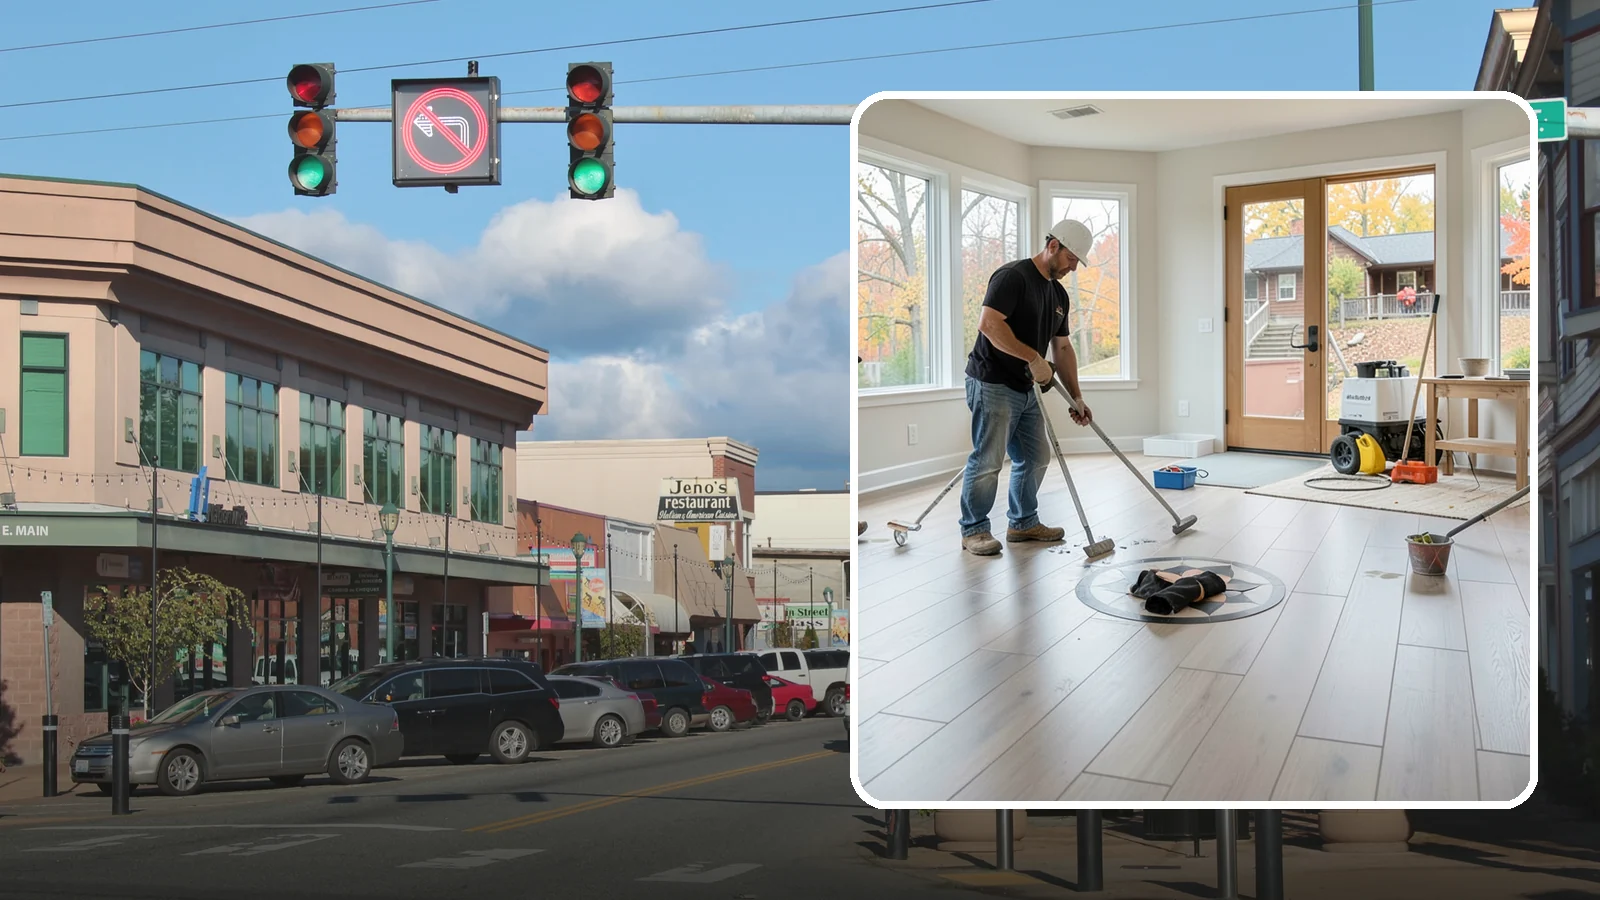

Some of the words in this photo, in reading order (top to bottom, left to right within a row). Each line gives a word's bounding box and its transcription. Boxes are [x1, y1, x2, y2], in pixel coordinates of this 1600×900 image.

[669, 480, 728, 495] Jeno's
[665, 496, 731, 509] restaurant
[658, 509, 681, 519] Italian
[685, 509, 715, 519] American
[714, 509, 738, 519] Cuisine
[2, 525, 13, 536] E.
[15, 525, 49, 537] MAIN
[797, 607, 829, 617] Street
[791, 619, 824, 627] lass
